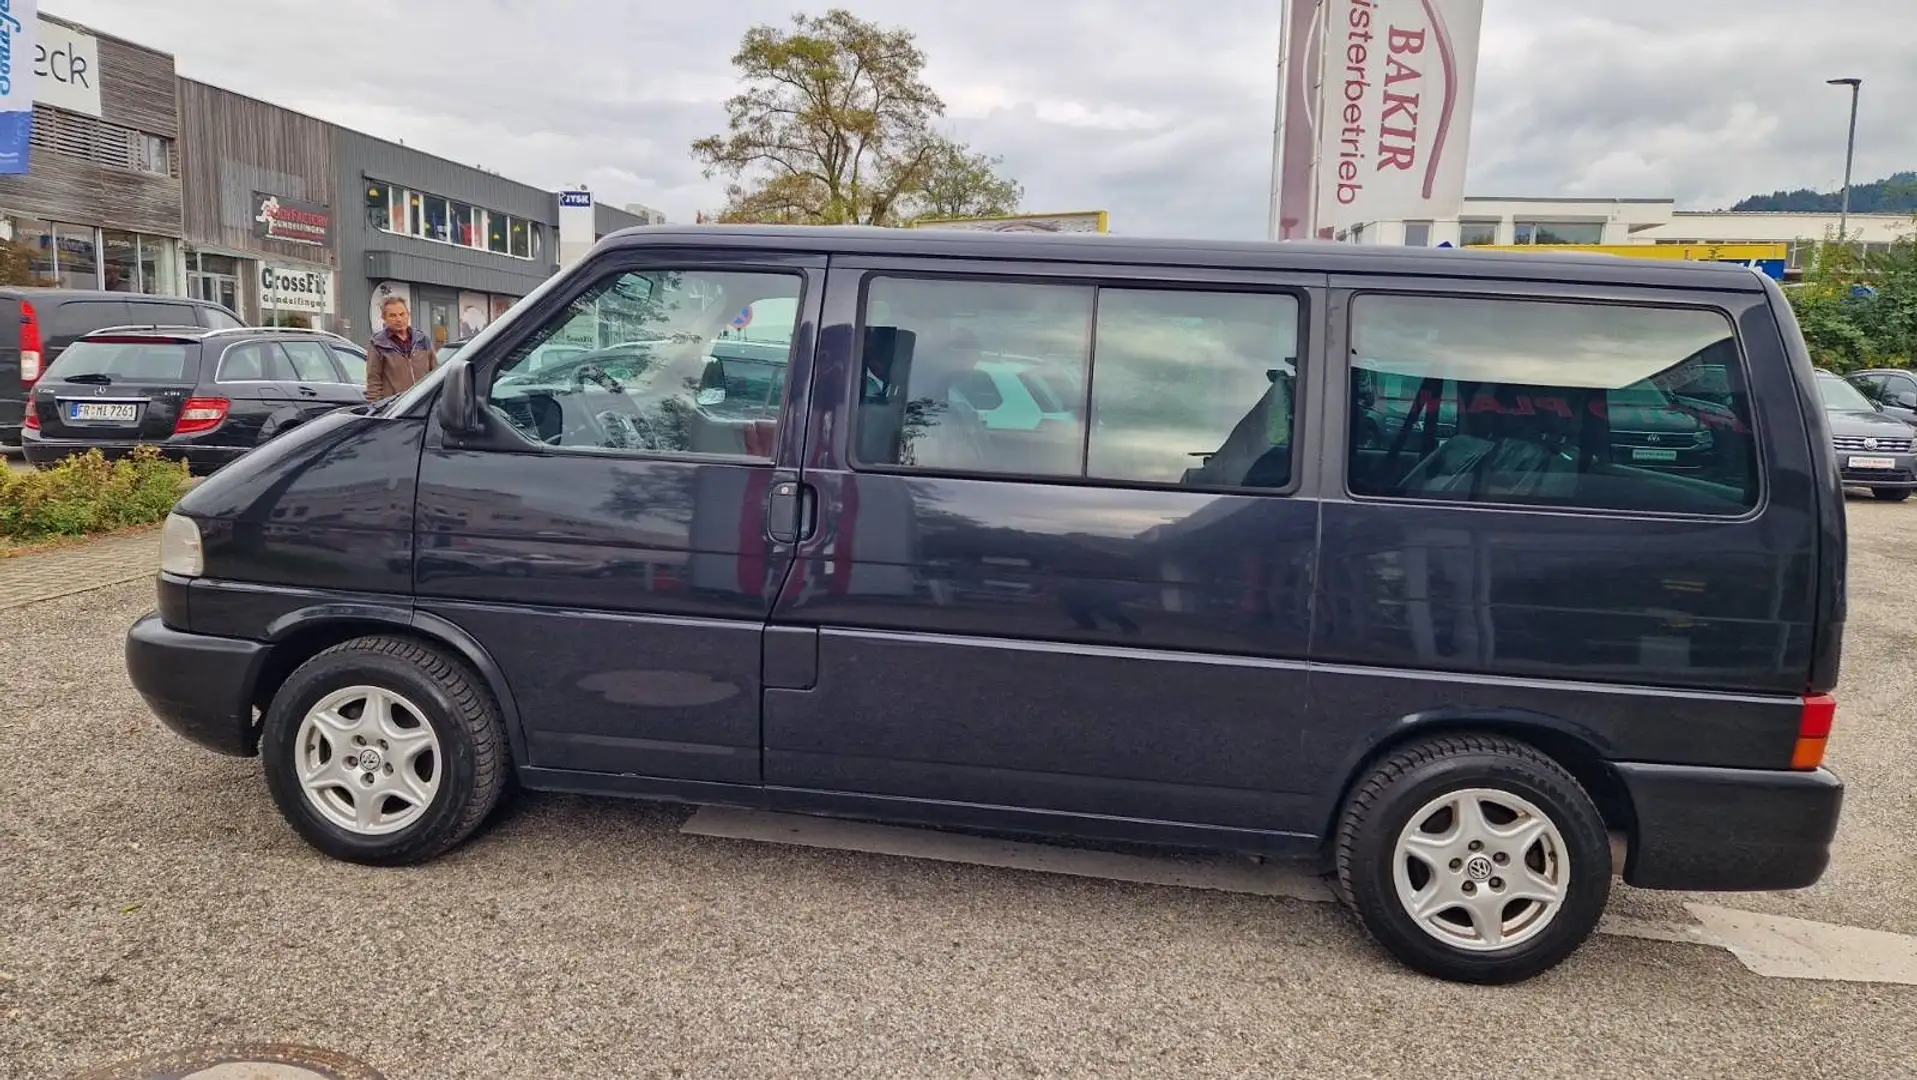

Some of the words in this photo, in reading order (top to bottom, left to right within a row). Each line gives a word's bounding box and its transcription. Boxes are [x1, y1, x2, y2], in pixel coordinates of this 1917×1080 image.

[1376, 24, 1428, 172] BAKIR
[565, 194, 590, 204] JYSK
[110, 405, 134, 417] 7261
